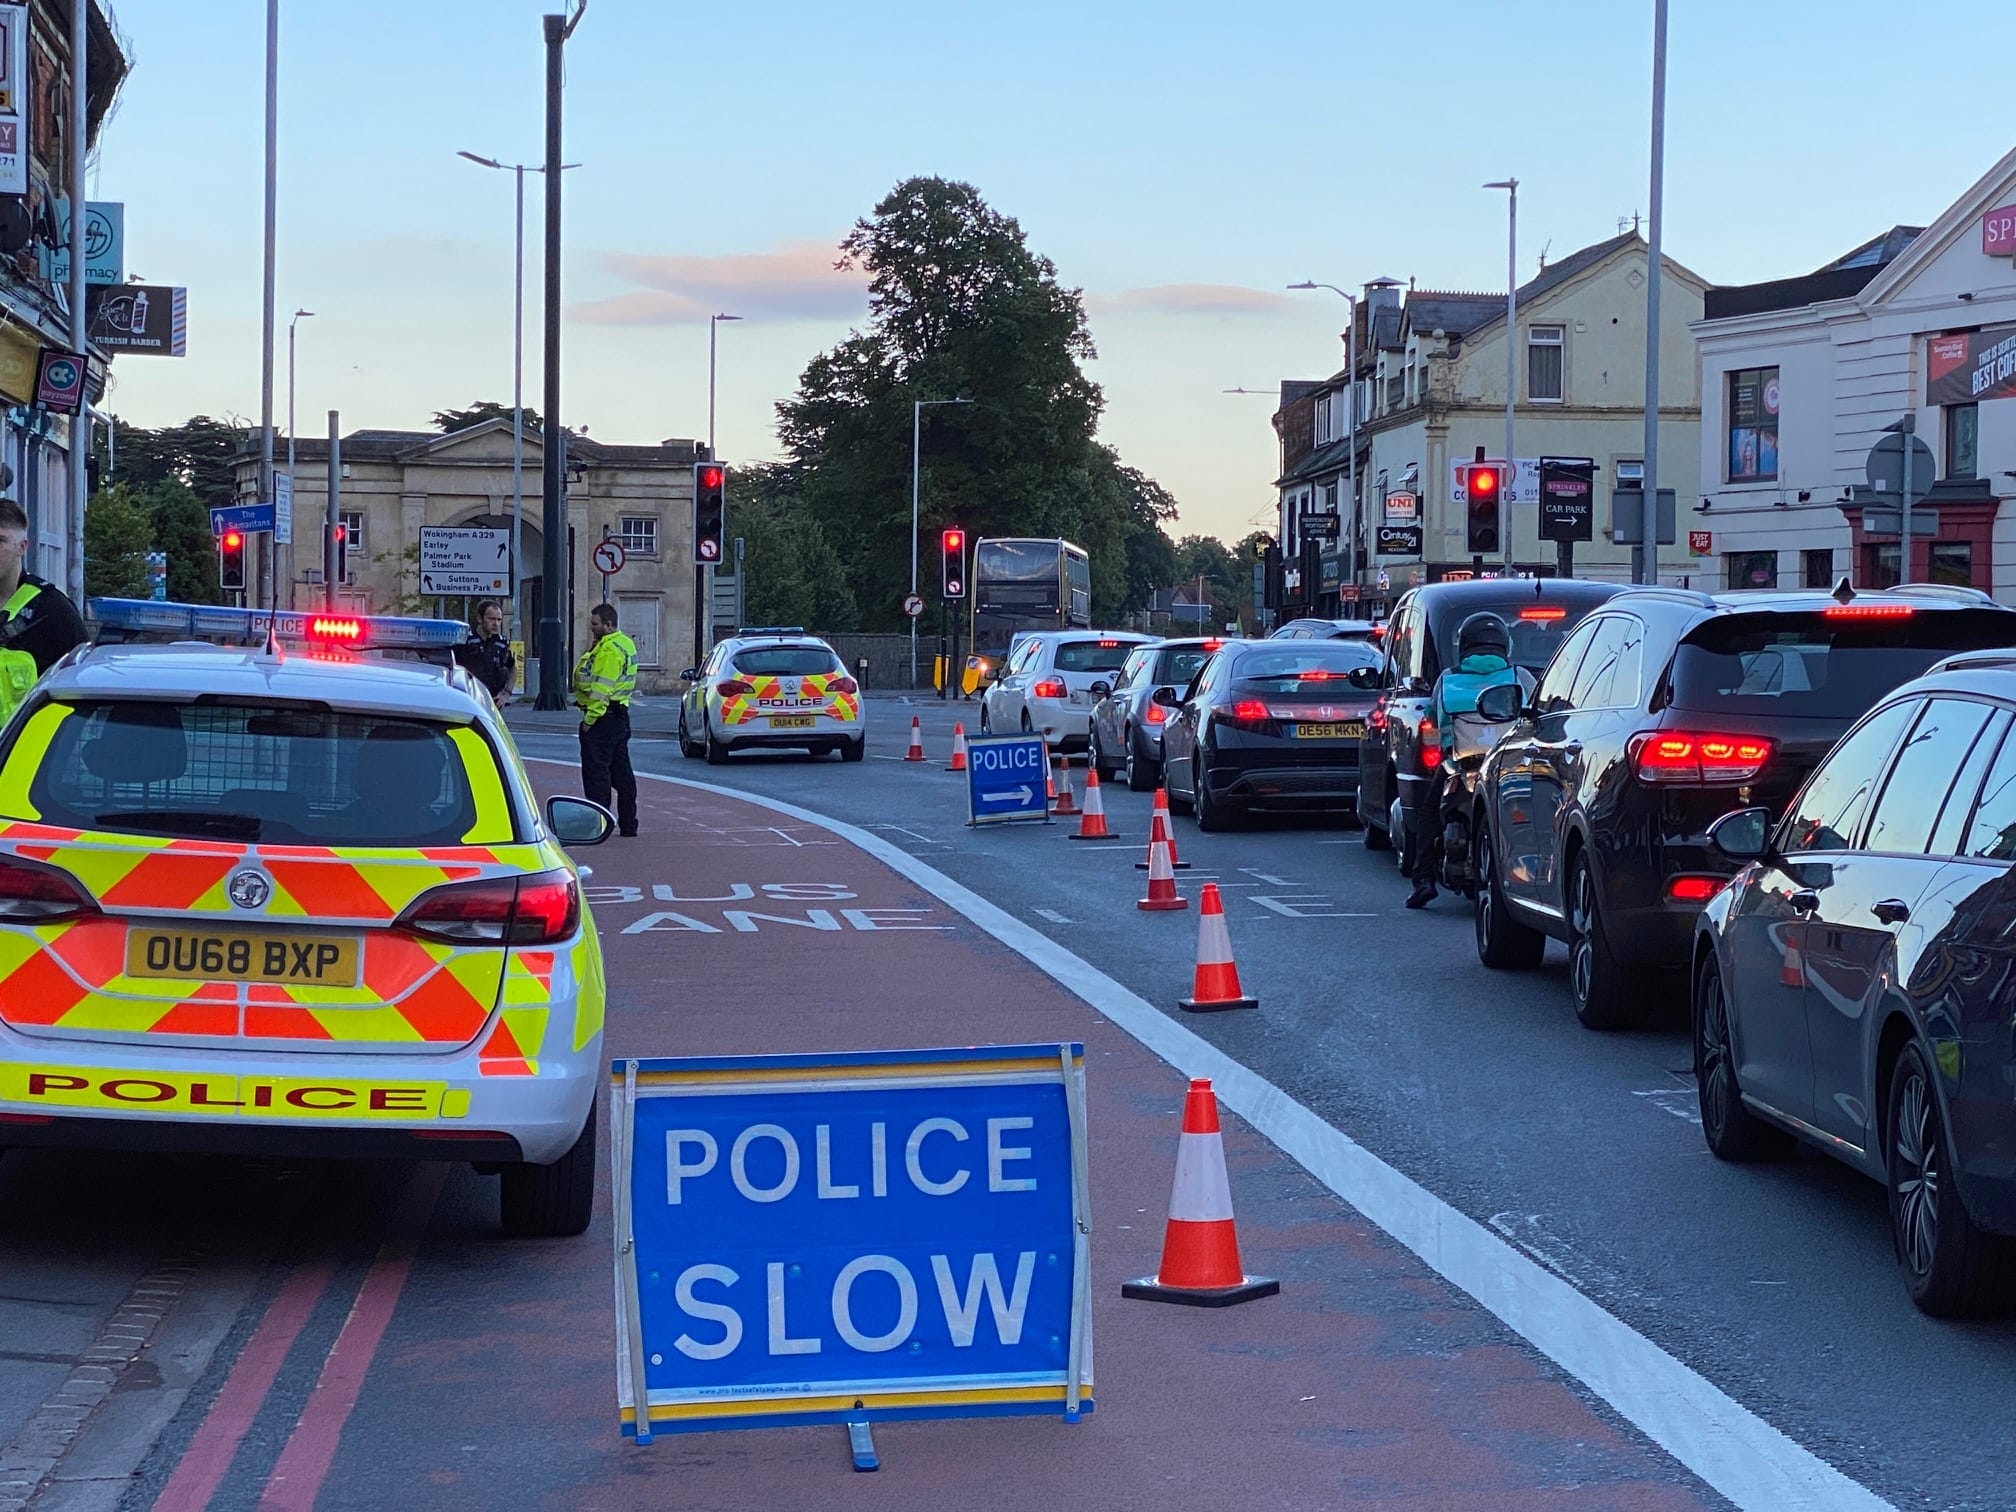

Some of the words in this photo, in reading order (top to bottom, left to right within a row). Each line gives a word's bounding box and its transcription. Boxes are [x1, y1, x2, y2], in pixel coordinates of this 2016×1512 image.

[1988, 216, 2016, 242] SP
[55, 265, 119, 282] phmacy
[95, 336, 128, 345] TURKISH
[131, 338, 161, 347] BARBER
[1979, 349, 1991, 366] THIS
[1991, 345, 1998, 359] IS
[1972, 360, 1996, 395] BEST
[41, 390, 76, 402] payzone
[1547, 483, 1586, 491] SPRINKLES
[1387, 498, 1413, 508] UNI
[1546, 504, 1563, 513] CAR
[1565, 505, 1587, 514] PARK
[241, 511, 256, 519] The
[228, 520, 271, 530] Samaritans
[424, 530, 469, 539] Wokingham
[1692, 533, 1709, 541] JUST
[423, 541, 449, 550] Earley
[1408, 536, 1416, 547] 21
[423, 552, 451, 560] Palmer
[454, 552, 472, 560] Park
[448, 575, 479, 583] Suttons
[473, 584, 491, 592] Park
[253, 617, 304, 633] POLICE
[759, 697, 823, 707] POLICE
[1298, 725, 1332, 736] OE56
[973, 748, 1038, 771] POLICE
[583, 883, 858, 904] BUS
[598, 908, 957, 935] ANE
[146, 936, 251, 976] OU68
[263, 941, 340, 980] BXP
[28, 1073, 428, 1112] POLICE
[665, 1116, 1038, 1205] POLICE
[673, 1250, 1037, 1361] SLOW
